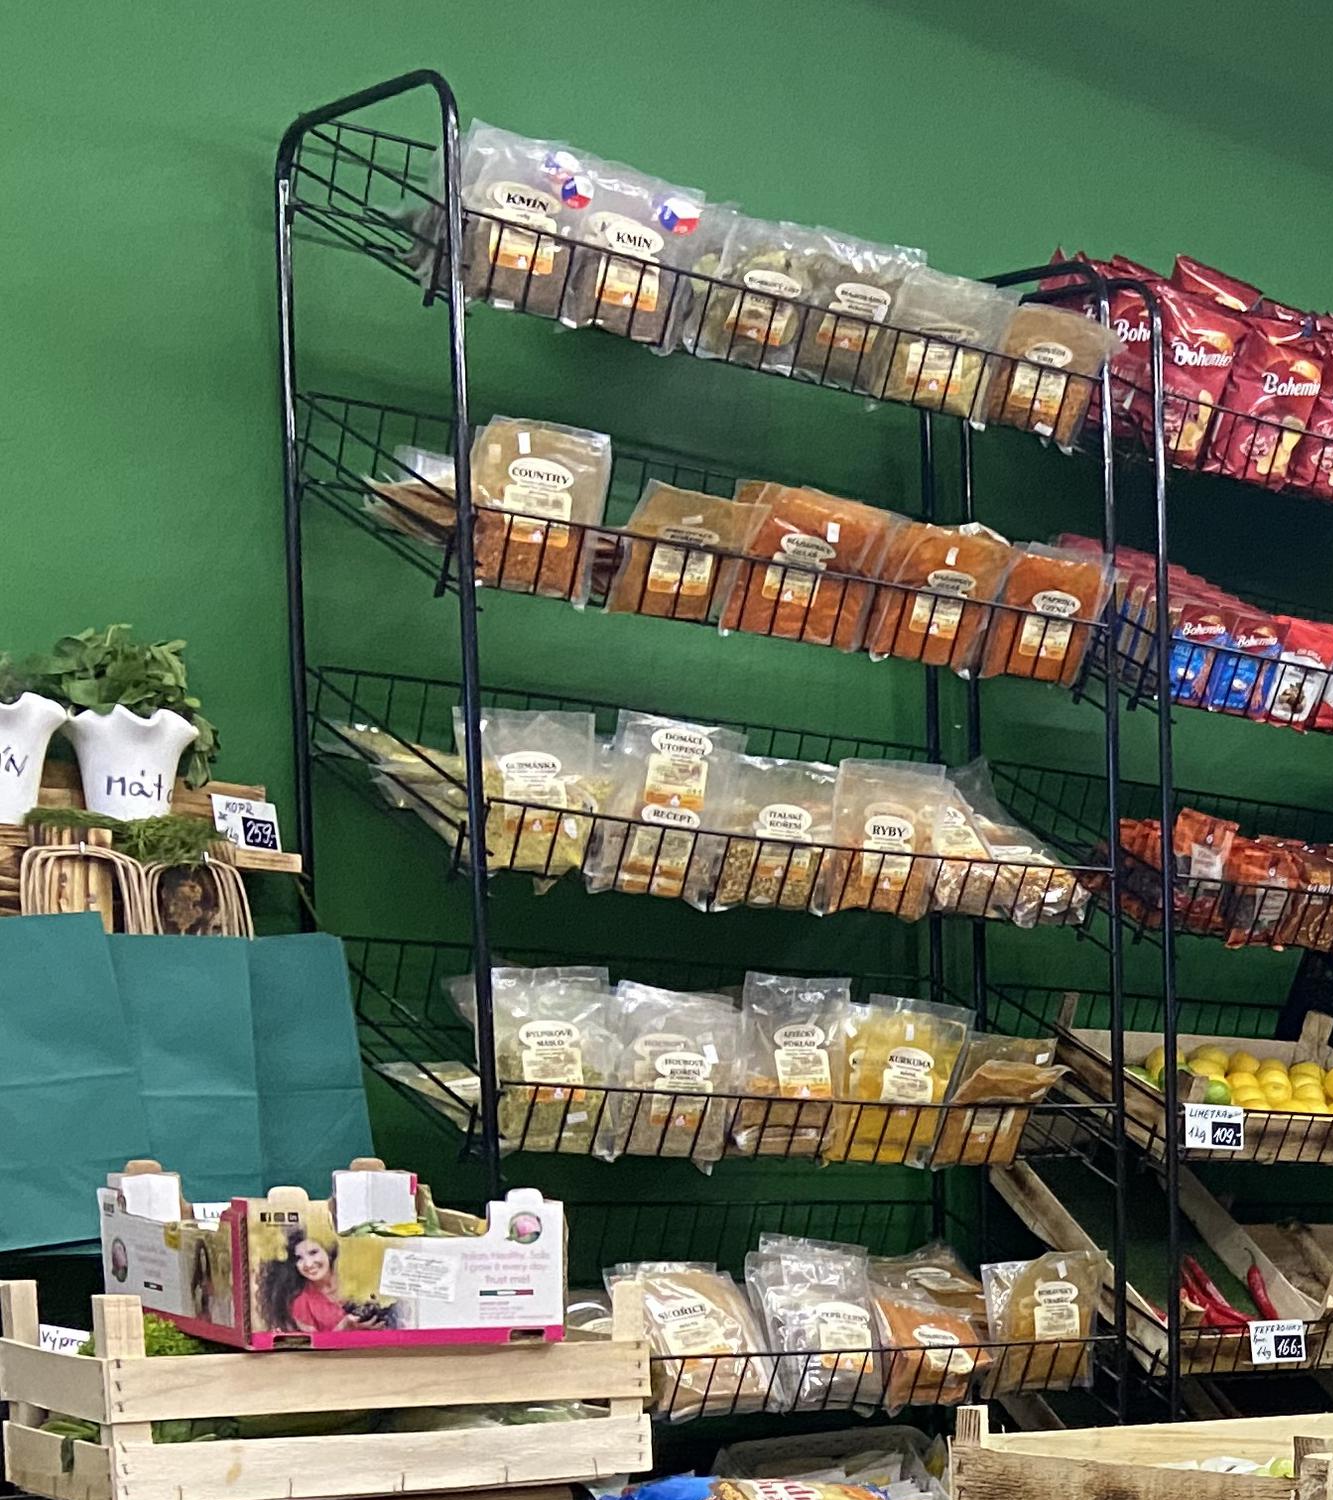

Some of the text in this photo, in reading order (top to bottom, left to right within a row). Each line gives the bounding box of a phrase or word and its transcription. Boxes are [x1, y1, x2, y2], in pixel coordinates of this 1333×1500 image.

[506, 192, 549, 212] KMÍN
[615, 231, 652, 249] KMÍN
[511, 466, 570, 485] COUNTRY
[1182, 621, 1226, 635] Bohemia
[1237, 635, 1278, 647] Bohemia
[225, 800, 254, 816] KOPR
[653, 809, 693, 824] RECEPT
[872, 824, 906, 838] RYBY
[888, 1054, 931, 1069] KURKUMA
[1189, 1108, 1227, 1119] LIMETKA
[657, 1303, 707, 1320] SKOŘICE
